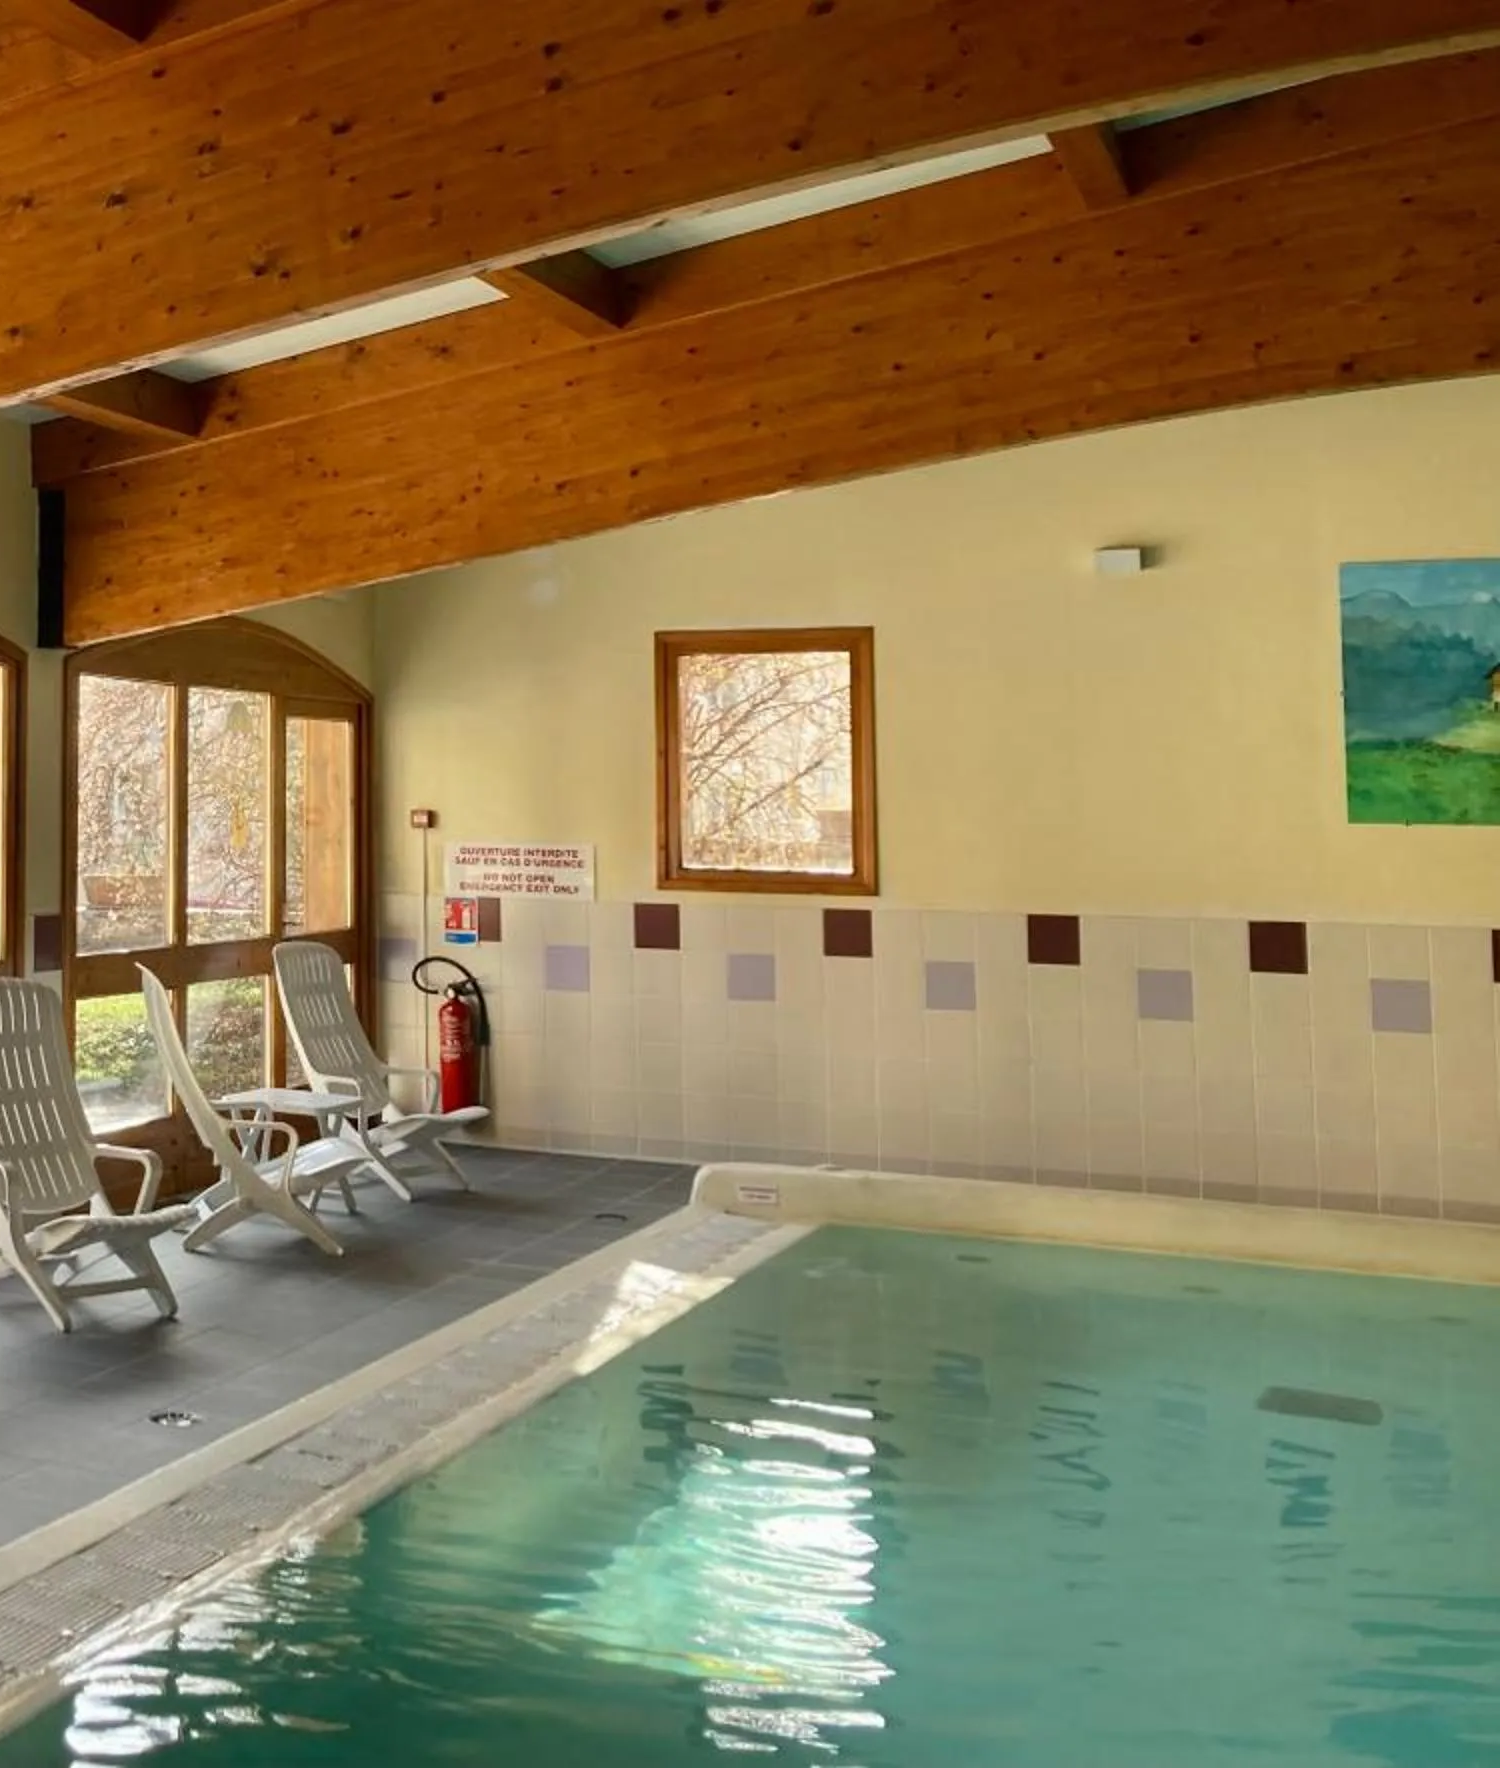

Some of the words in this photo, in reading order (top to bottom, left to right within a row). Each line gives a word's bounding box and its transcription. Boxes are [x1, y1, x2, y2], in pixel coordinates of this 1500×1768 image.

[459, 847, 521, 857] OUVERTURE
[523, 848, 579, 859] INTERDITE
[455, 856, 481, 866] SAUF
[483, 857, 498, 866] EN
[500, 857, 521, 867] CAS
[523, 858, 585, 869] D'URGENCE
[501, 873, 523, 883] NOT
[525, 874, 555, 884] OPEN
[459, 881, 523, 892] EMERGENCY
[525, 884, 550, 893] EXIT
[553, 885, 579, 895] ONLY
